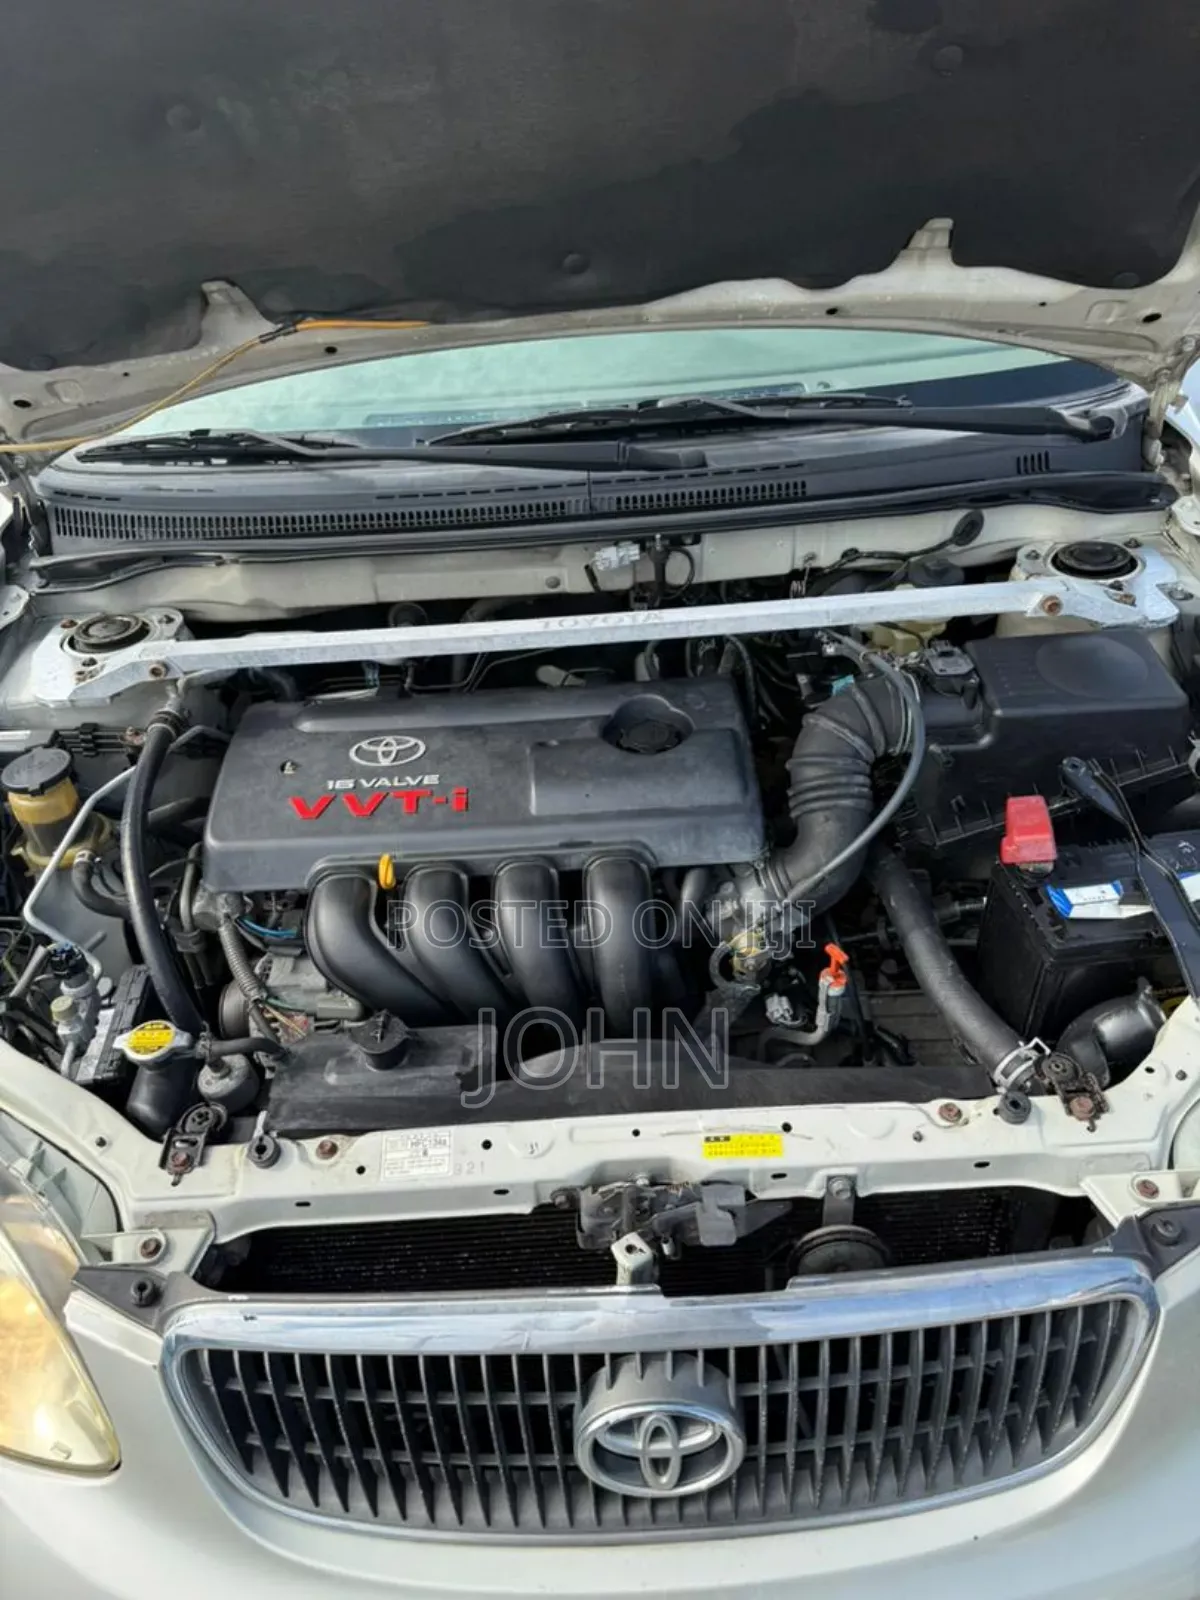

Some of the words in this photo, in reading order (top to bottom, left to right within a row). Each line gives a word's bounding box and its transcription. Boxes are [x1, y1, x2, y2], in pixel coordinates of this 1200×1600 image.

[327, 779, 355, 790] 16
[359, 774, 440, 788] VALVE
[289, 786, 469, 820] VVT-i
